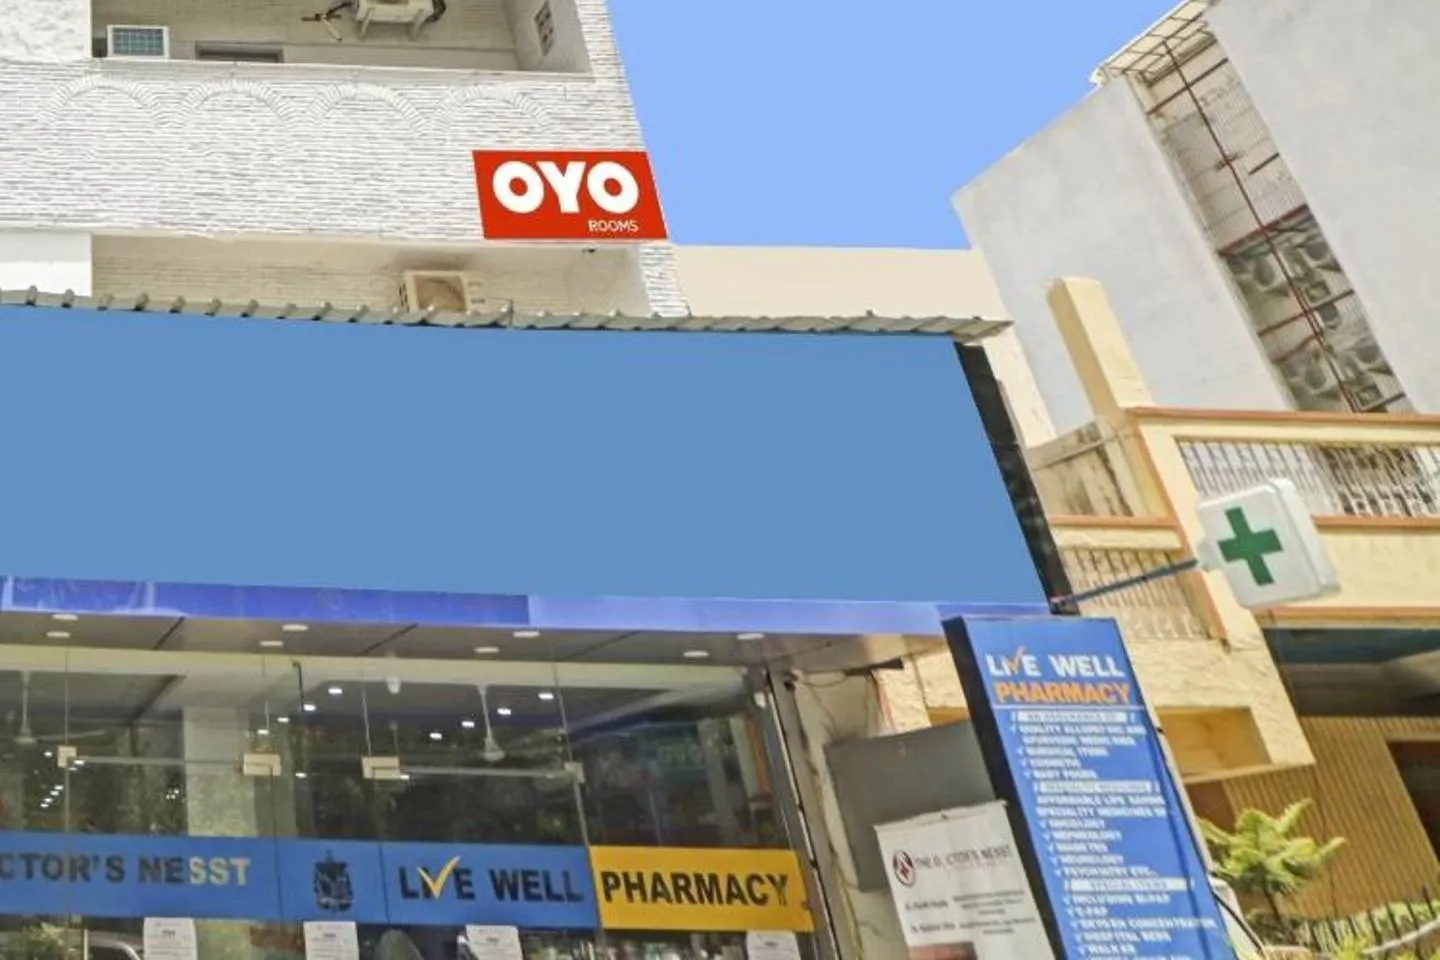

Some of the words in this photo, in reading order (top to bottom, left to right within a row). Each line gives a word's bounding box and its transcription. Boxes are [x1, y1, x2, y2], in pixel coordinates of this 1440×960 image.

[493, 161, 639, 214] OYO
[589, 220, 639, 232] ROOMS
[1048, 654, 1125, 677] WELL
[994, 681, 1130, 703] PHARMACY
[138, 856, 251, 886] NESST
[490, 869, 585, 903] WELL
[602, 870, 789, 907] PHARMACY
